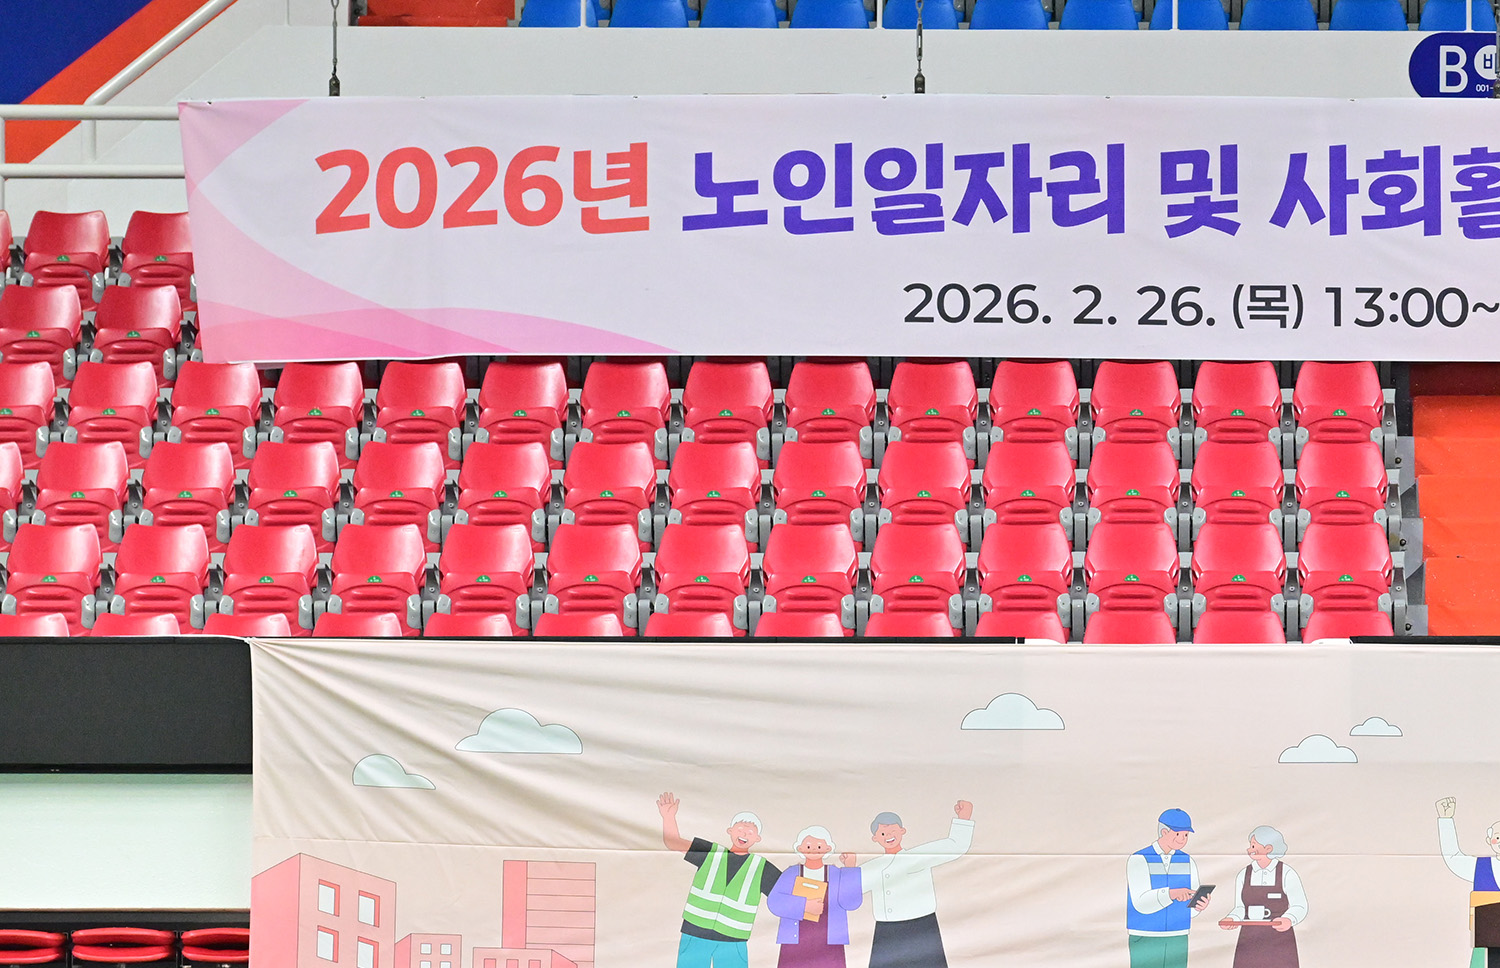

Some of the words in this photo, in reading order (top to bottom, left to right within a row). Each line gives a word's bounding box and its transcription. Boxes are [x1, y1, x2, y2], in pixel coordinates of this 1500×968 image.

[1439, 45, 1468, 93] B
[316, 142, 650, 235] 2026년
[682, 143, 1125, 236] 노인일자리
[1160, 144, 1241, 239] 및
[903, 283, 1052, 325] 2026.
[1072, 285, 1117, 326] 2.
[1136, 285, 1216, 327] 26.
[1232, 283, 1304, 330] (목)
